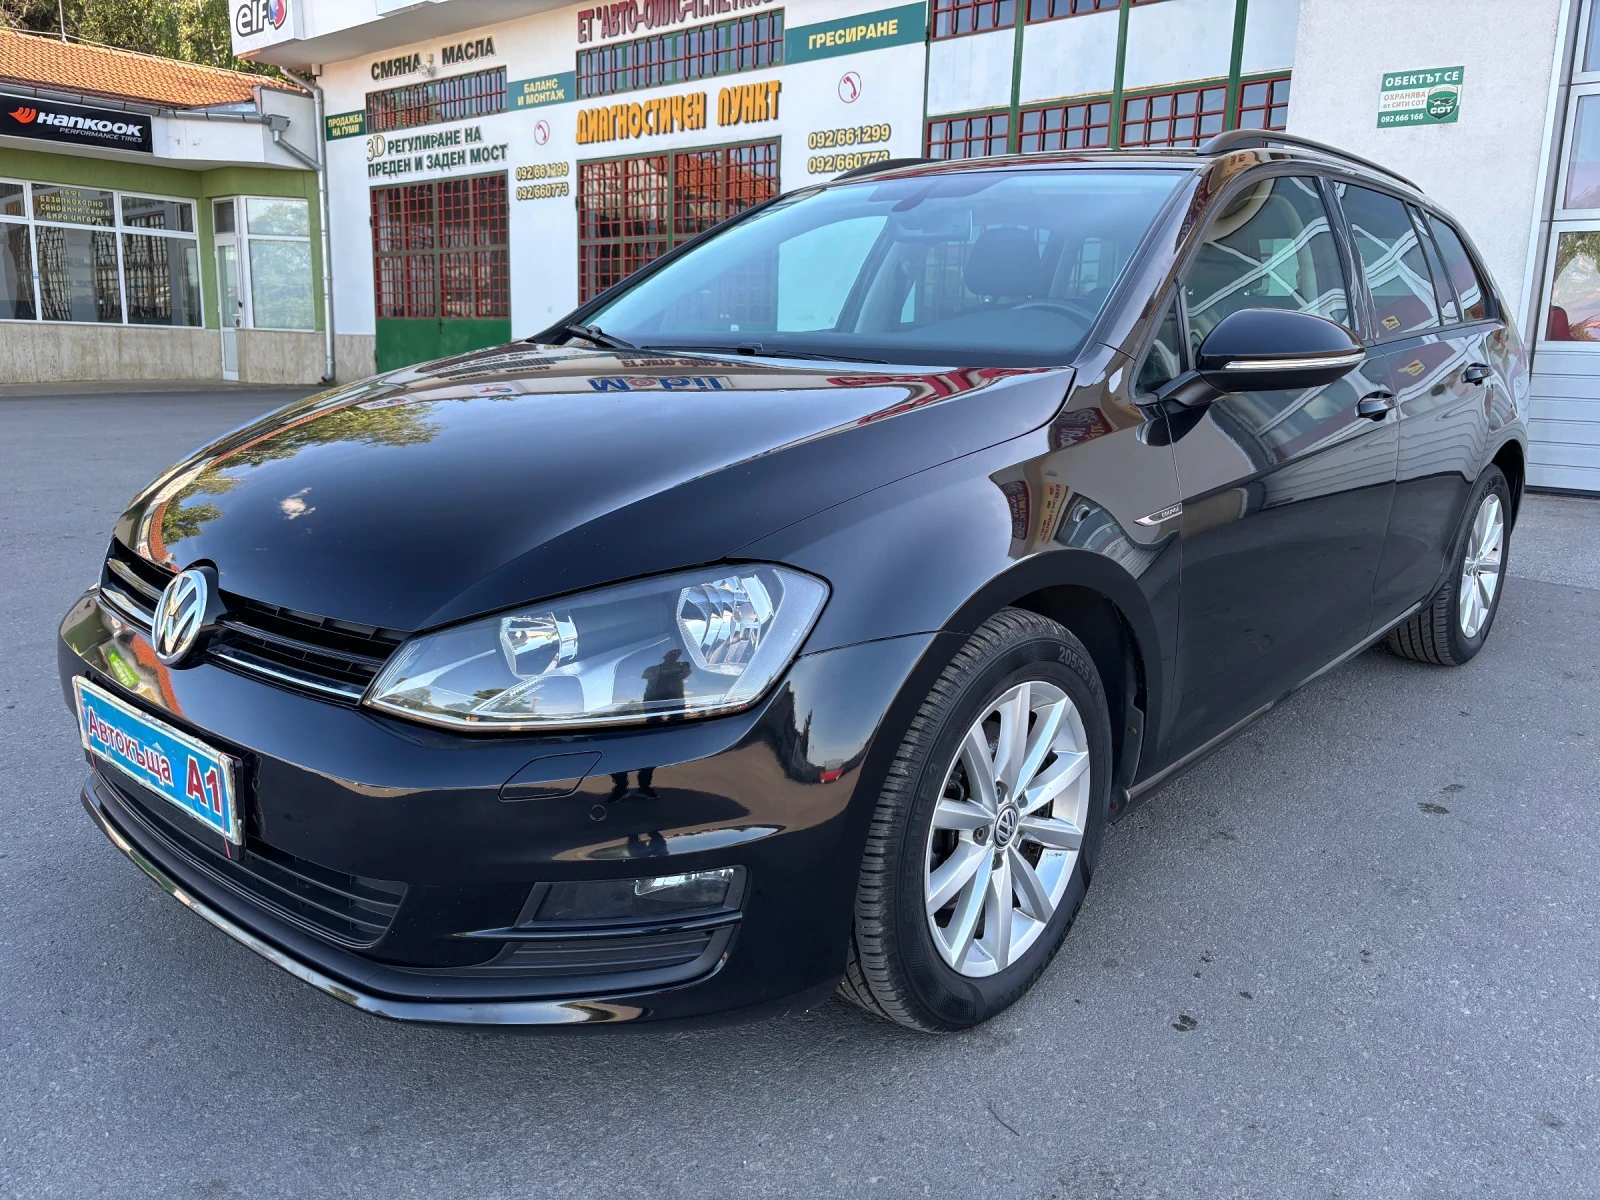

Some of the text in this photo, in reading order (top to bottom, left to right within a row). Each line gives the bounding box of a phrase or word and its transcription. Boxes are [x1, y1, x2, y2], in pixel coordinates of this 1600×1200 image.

[578, 9, 594, 43] ЕТ
[808, 18, 899, 50] ГРЕСИРАНЕ
[371, 36, 496, 80] СМЯНА МАСЛА
[523, 78, 558, 94] БАЛАНС
[1385, 71, 1460, 87] ОБЕКТЪТ СЕ
[517, 88, 565, 107] И МОНТАЖ
[1383, 91, 1426, 102] ОХРАНЯВА
[576, 79, 782, 145] ДИАГНОСТИЧЕН ПУНКТ
[1381, 112, 1424, 123] 092 666 166
[1430, 105, 1453, 114] СОТ
[327, 114, 363, 128] ПРОДАЖБА
[332, 124, 360, 137] НА ГУМИ
[59, 127, 143, 143] PERFORMANCE TIRES
[366, 125, 484, 162] 3D РЕГУЛИРАНЕ НА
[807, 122, 892, 150] 092/661299
[367, 143, 509, 179] ПРЕДЕН И ЗАДЕН МОСТ
[60, 188, 82, 197] КАФЕ
[516, 181, 569, 201] 092/660773
[1058, 646, 1090, 681] 205/55
[88, 706, 222, 816] Автокъща А1
